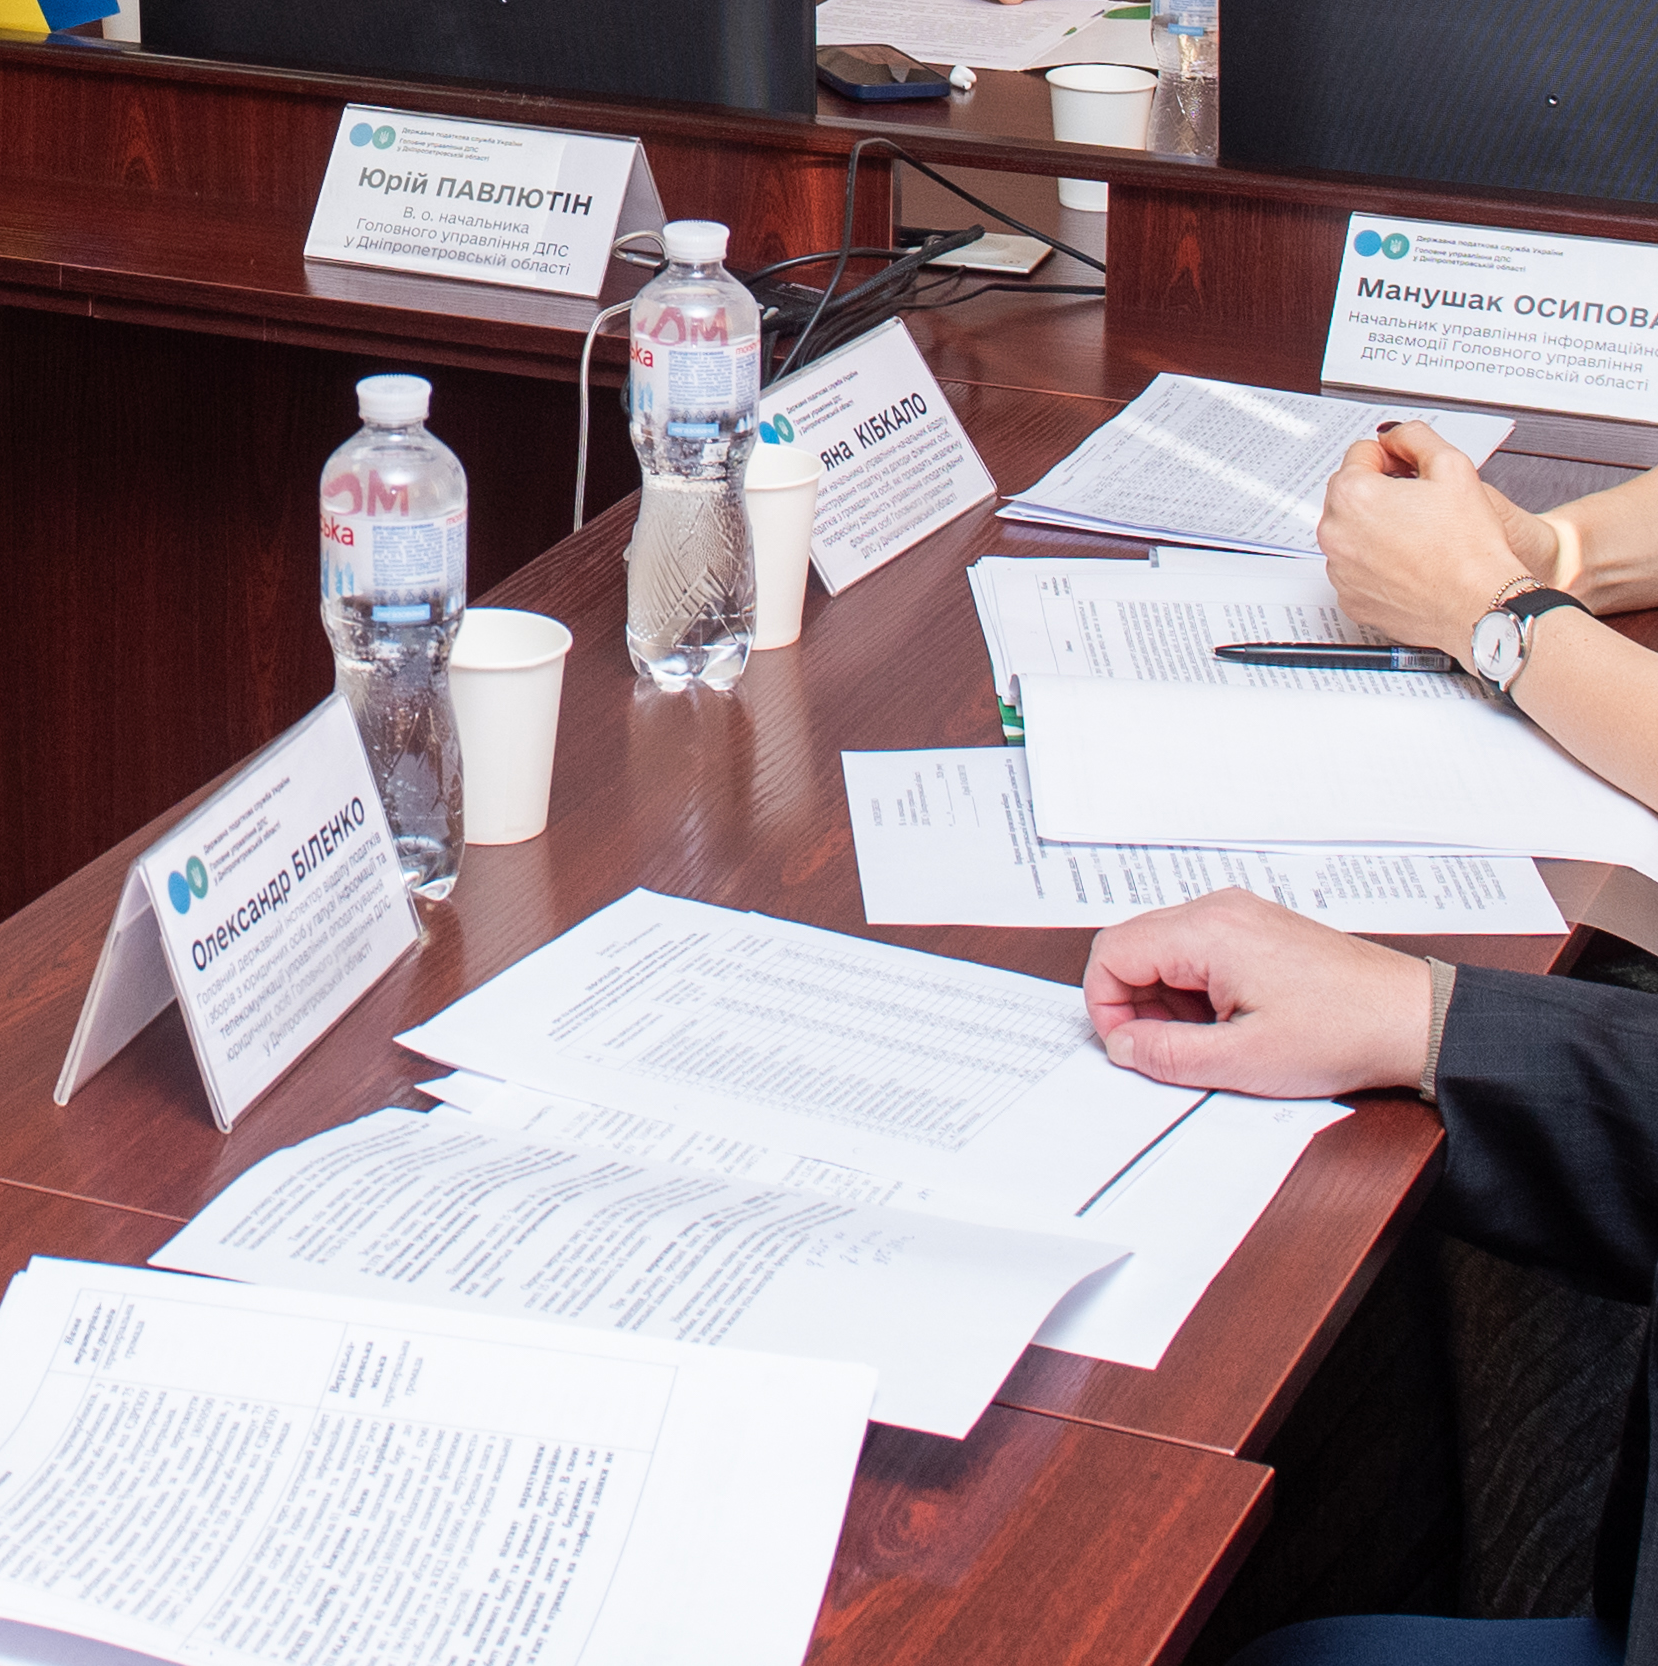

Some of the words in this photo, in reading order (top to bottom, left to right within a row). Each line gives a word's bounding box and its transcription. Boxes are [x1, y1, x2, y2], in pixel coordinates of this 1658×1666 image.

[357, 166, 428, 195] Юрій
[435, 176, 593, 216] ПАВЛЮТІН
[355, 217, 437, 239] Головного
[439, 230, 530, 251] управління
[531, 241, 569, 257] ДПС
[402, 205, 415, 219] В.
[420, 210, 433, 221] о.
[438, 212, 529, 234] начальника
[343, 235, 355, 248] у
[355, 235, 507, 267] Дніпропетровській
[510, 257, 571, 275] області
[1356, 276, 1504, 312] Манушак
[1347, 310, 1437, 332] Начальник
[1441, 323, 1537, 342] управління
[1359, 345, 1398, 361] ДПС
[1400, 352, 1412, 366] у
[1414, 352, 1579, 383] Дніпропетровській
[1583, 373, 1648, 391] області
[1367, 331, 1448, 351] взаємодії
[1451, 339, 1541, 361] Головного
[1545, 352, 1643, 373] управління
[852, 392, 927, 449] КІБКАЛО
[191, 869, 291, 971] Олександр
[290, 796, 364, 882] БІЛЕНКО
